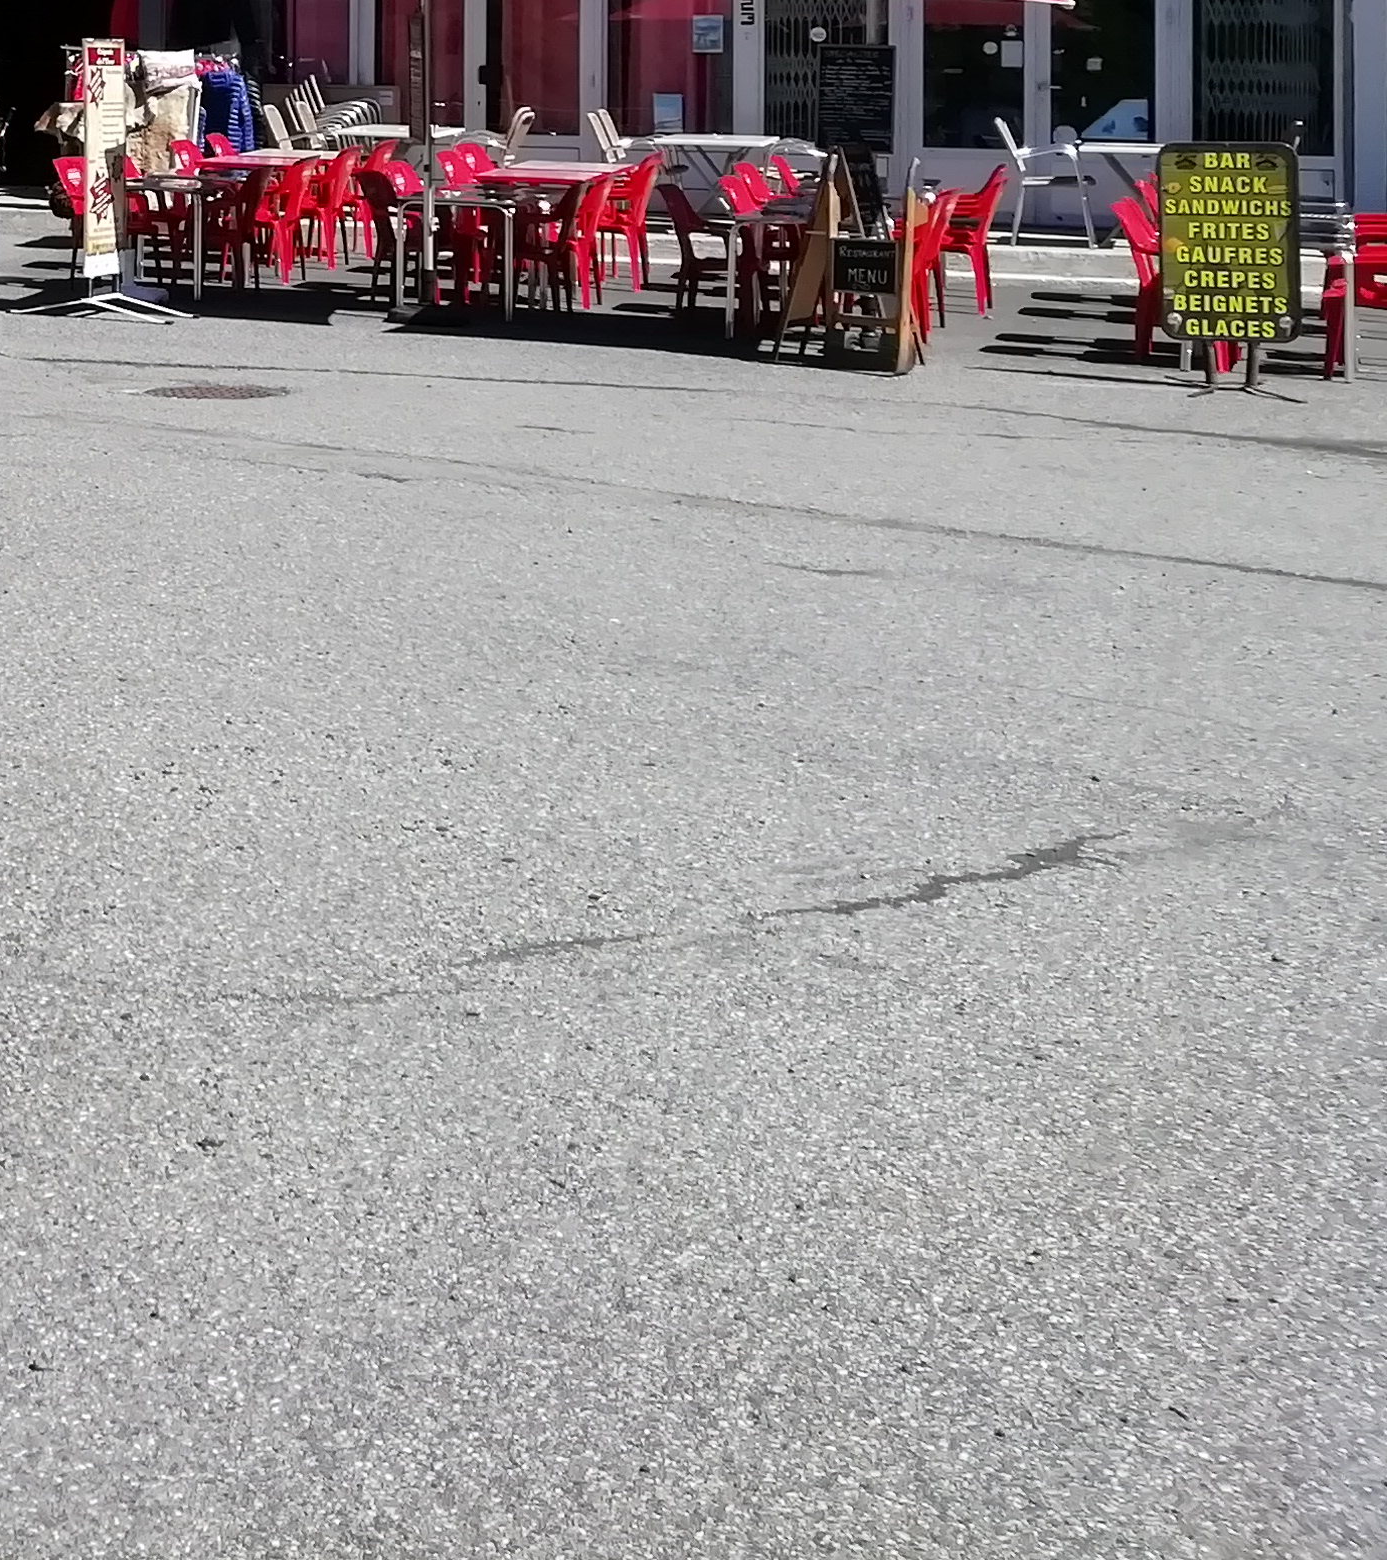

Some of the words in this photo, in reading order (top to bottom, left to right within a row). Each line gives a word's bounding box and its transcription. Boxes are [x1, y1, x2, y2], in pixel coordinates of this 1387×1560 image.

[1203, 152, 1251, 169] BAR
[1189, 176, 1268, 194] SNACK
[1165, 198, 1292, 216] SANDWICHS
[1188, 222, 1270, 240] FRITES
[1176, 245, 1284, 265] GAUFRES
[847, 268, 888, 285] MENU
[1184, 270, 1276, 290] CREPES
[1173, 294, 1288, 315] BEIGNETS
[1185, 318, 1276, 338] GLACES
